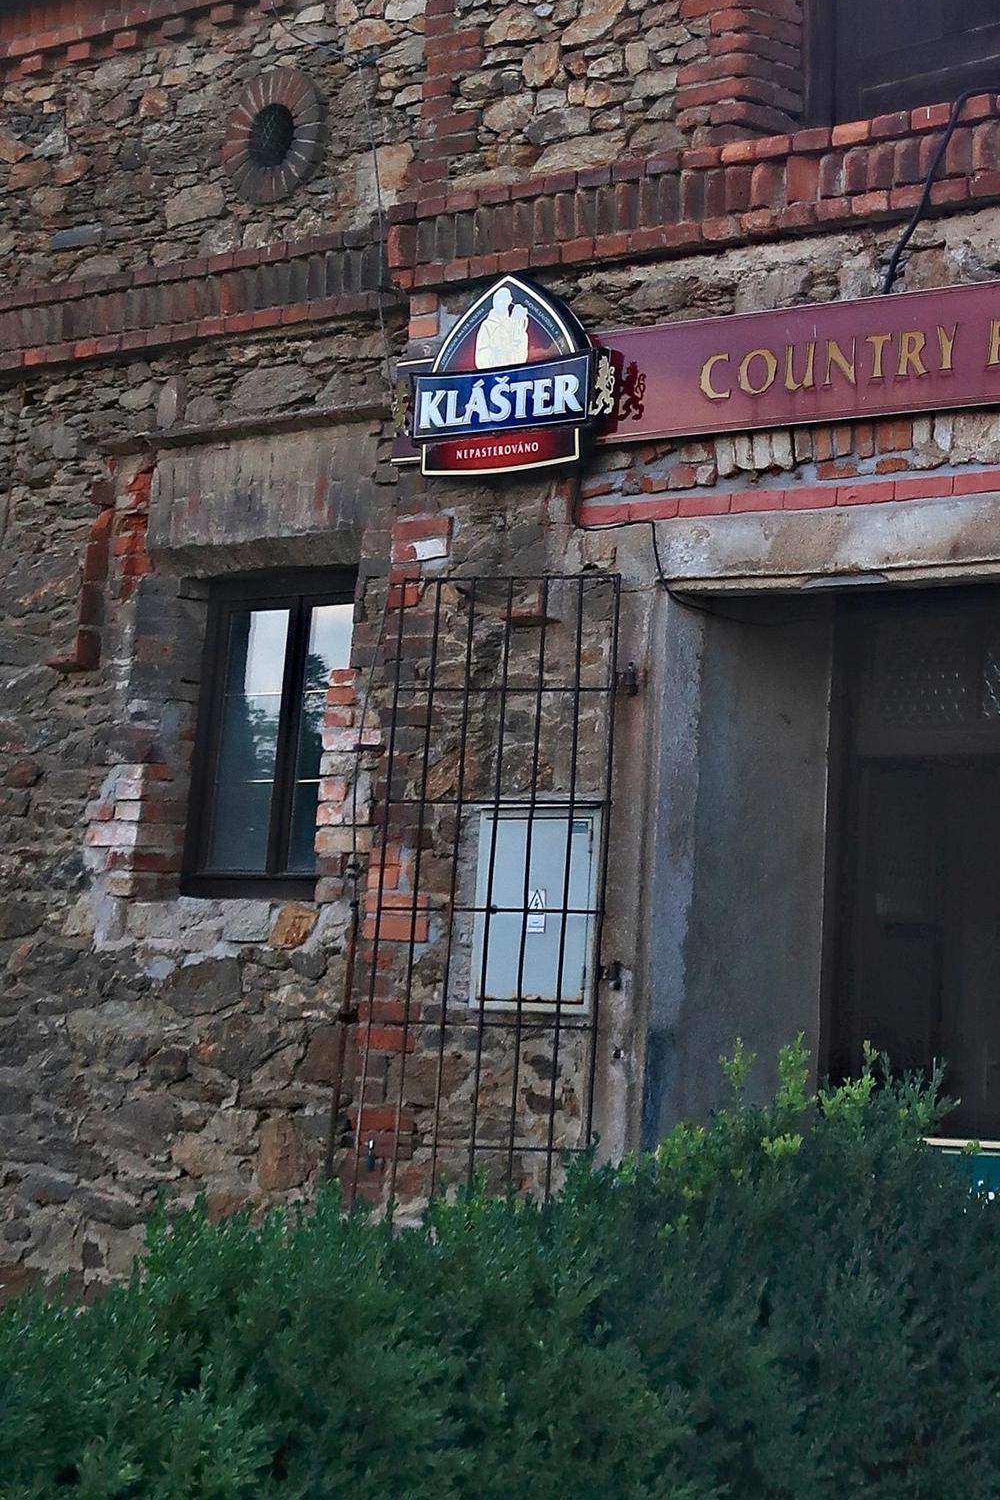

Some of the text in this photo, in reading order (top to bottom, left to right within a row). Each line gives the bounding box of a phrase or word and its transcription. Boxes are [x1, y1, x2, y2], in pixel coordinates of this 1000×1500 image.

[700, 323, 957, 400] COUNTRY
[419, 375, 583, 429] KLÁŠTER
[456, 441, 539, 460] NEPASTEROVÁNO
